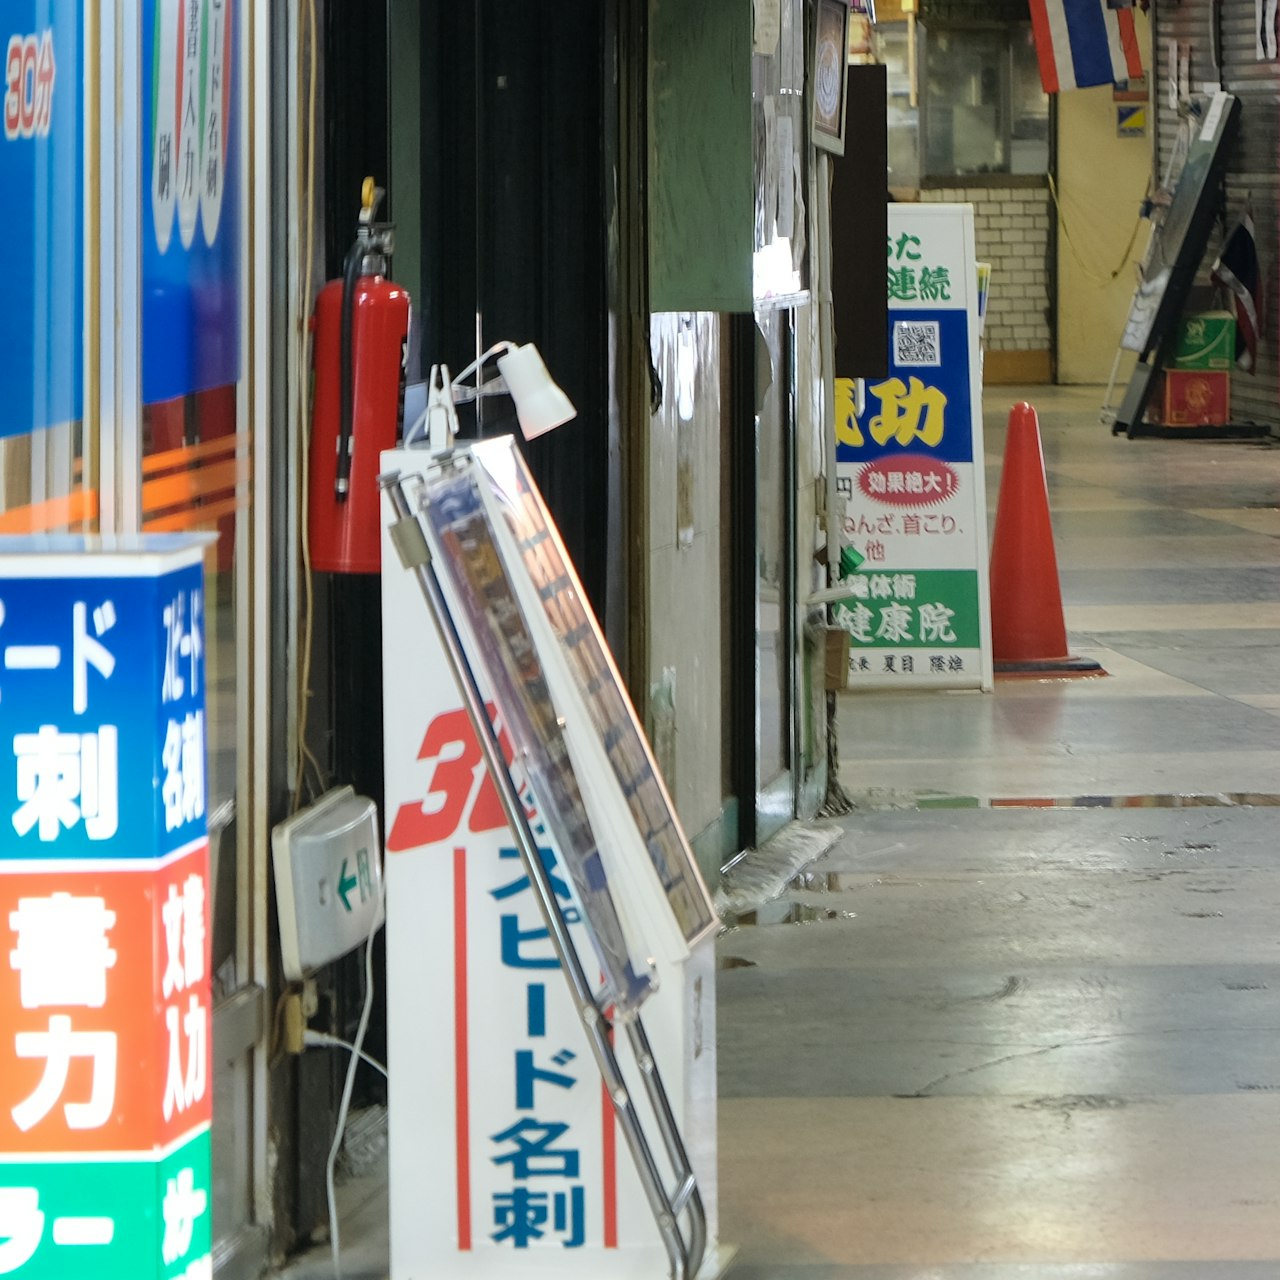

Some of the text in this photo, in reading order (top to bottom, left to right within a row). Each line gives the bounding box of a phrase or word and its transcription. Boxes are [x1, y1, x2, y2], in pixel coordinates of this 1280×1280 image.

[5, 30, 55, 140] 30分
[0, 599, 117, 715] ード
[162, 587, 203, 702] スピード
[162, 710, 204, 833] 名刺
[162, 872, 205, 995] 文書
[162, 998, 206, 1122] 入力
[487, 847, 587, 1251] スピード名刺
